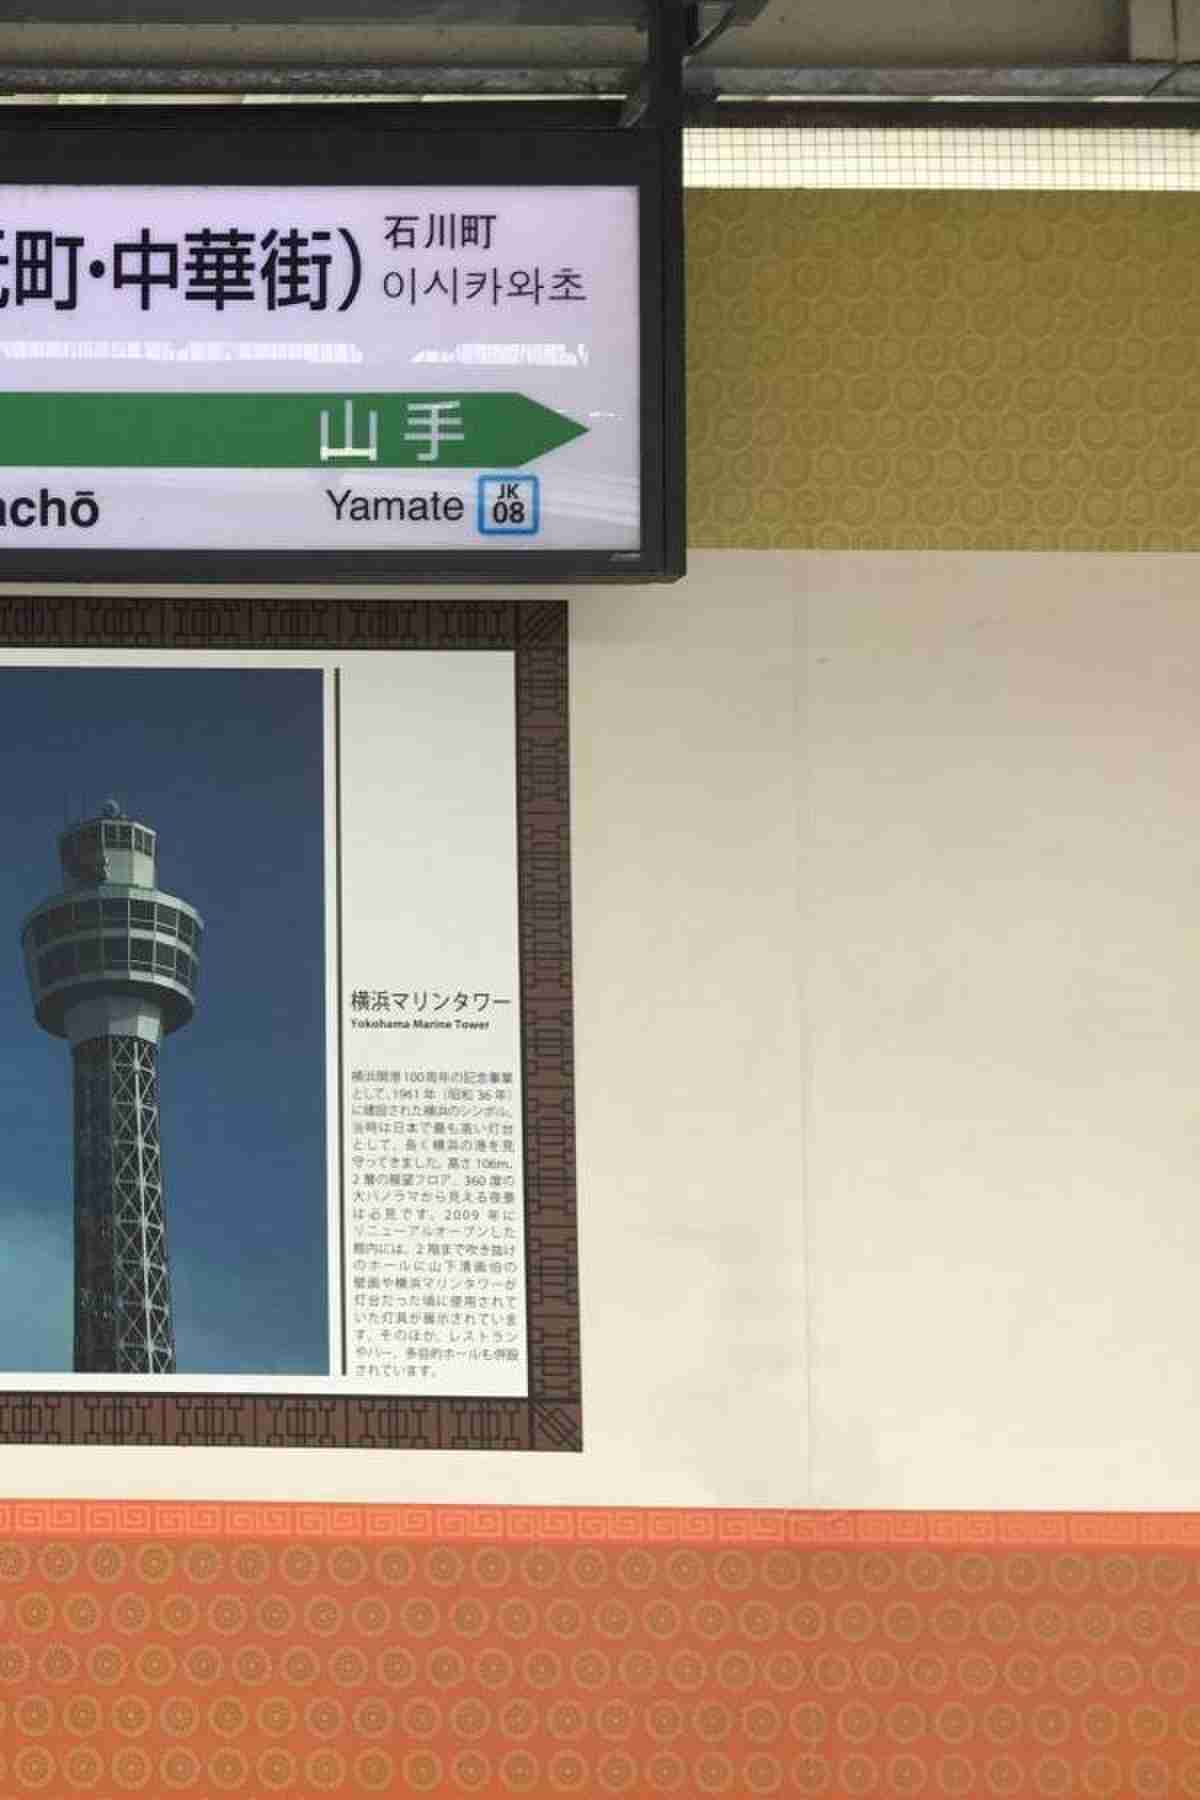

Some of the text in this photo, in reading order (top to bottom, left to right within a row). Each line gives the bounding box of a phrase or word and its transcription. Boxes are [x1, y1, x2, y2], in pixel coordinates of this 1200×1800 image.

[384, 213, 497, 250] 石川町
[383, 267, 587, 306] 이시카와초
[319, 399, 465, 461] 山手
[325, 489, 465, 522] Yamate
[497, 483, 519, 500] JK
[492, 501, 525, 524] 08
[351, 989, 511, 1013] 横浜マリンタワー
[351, 1019, 490, 1031] Yokohama Marine Tower
